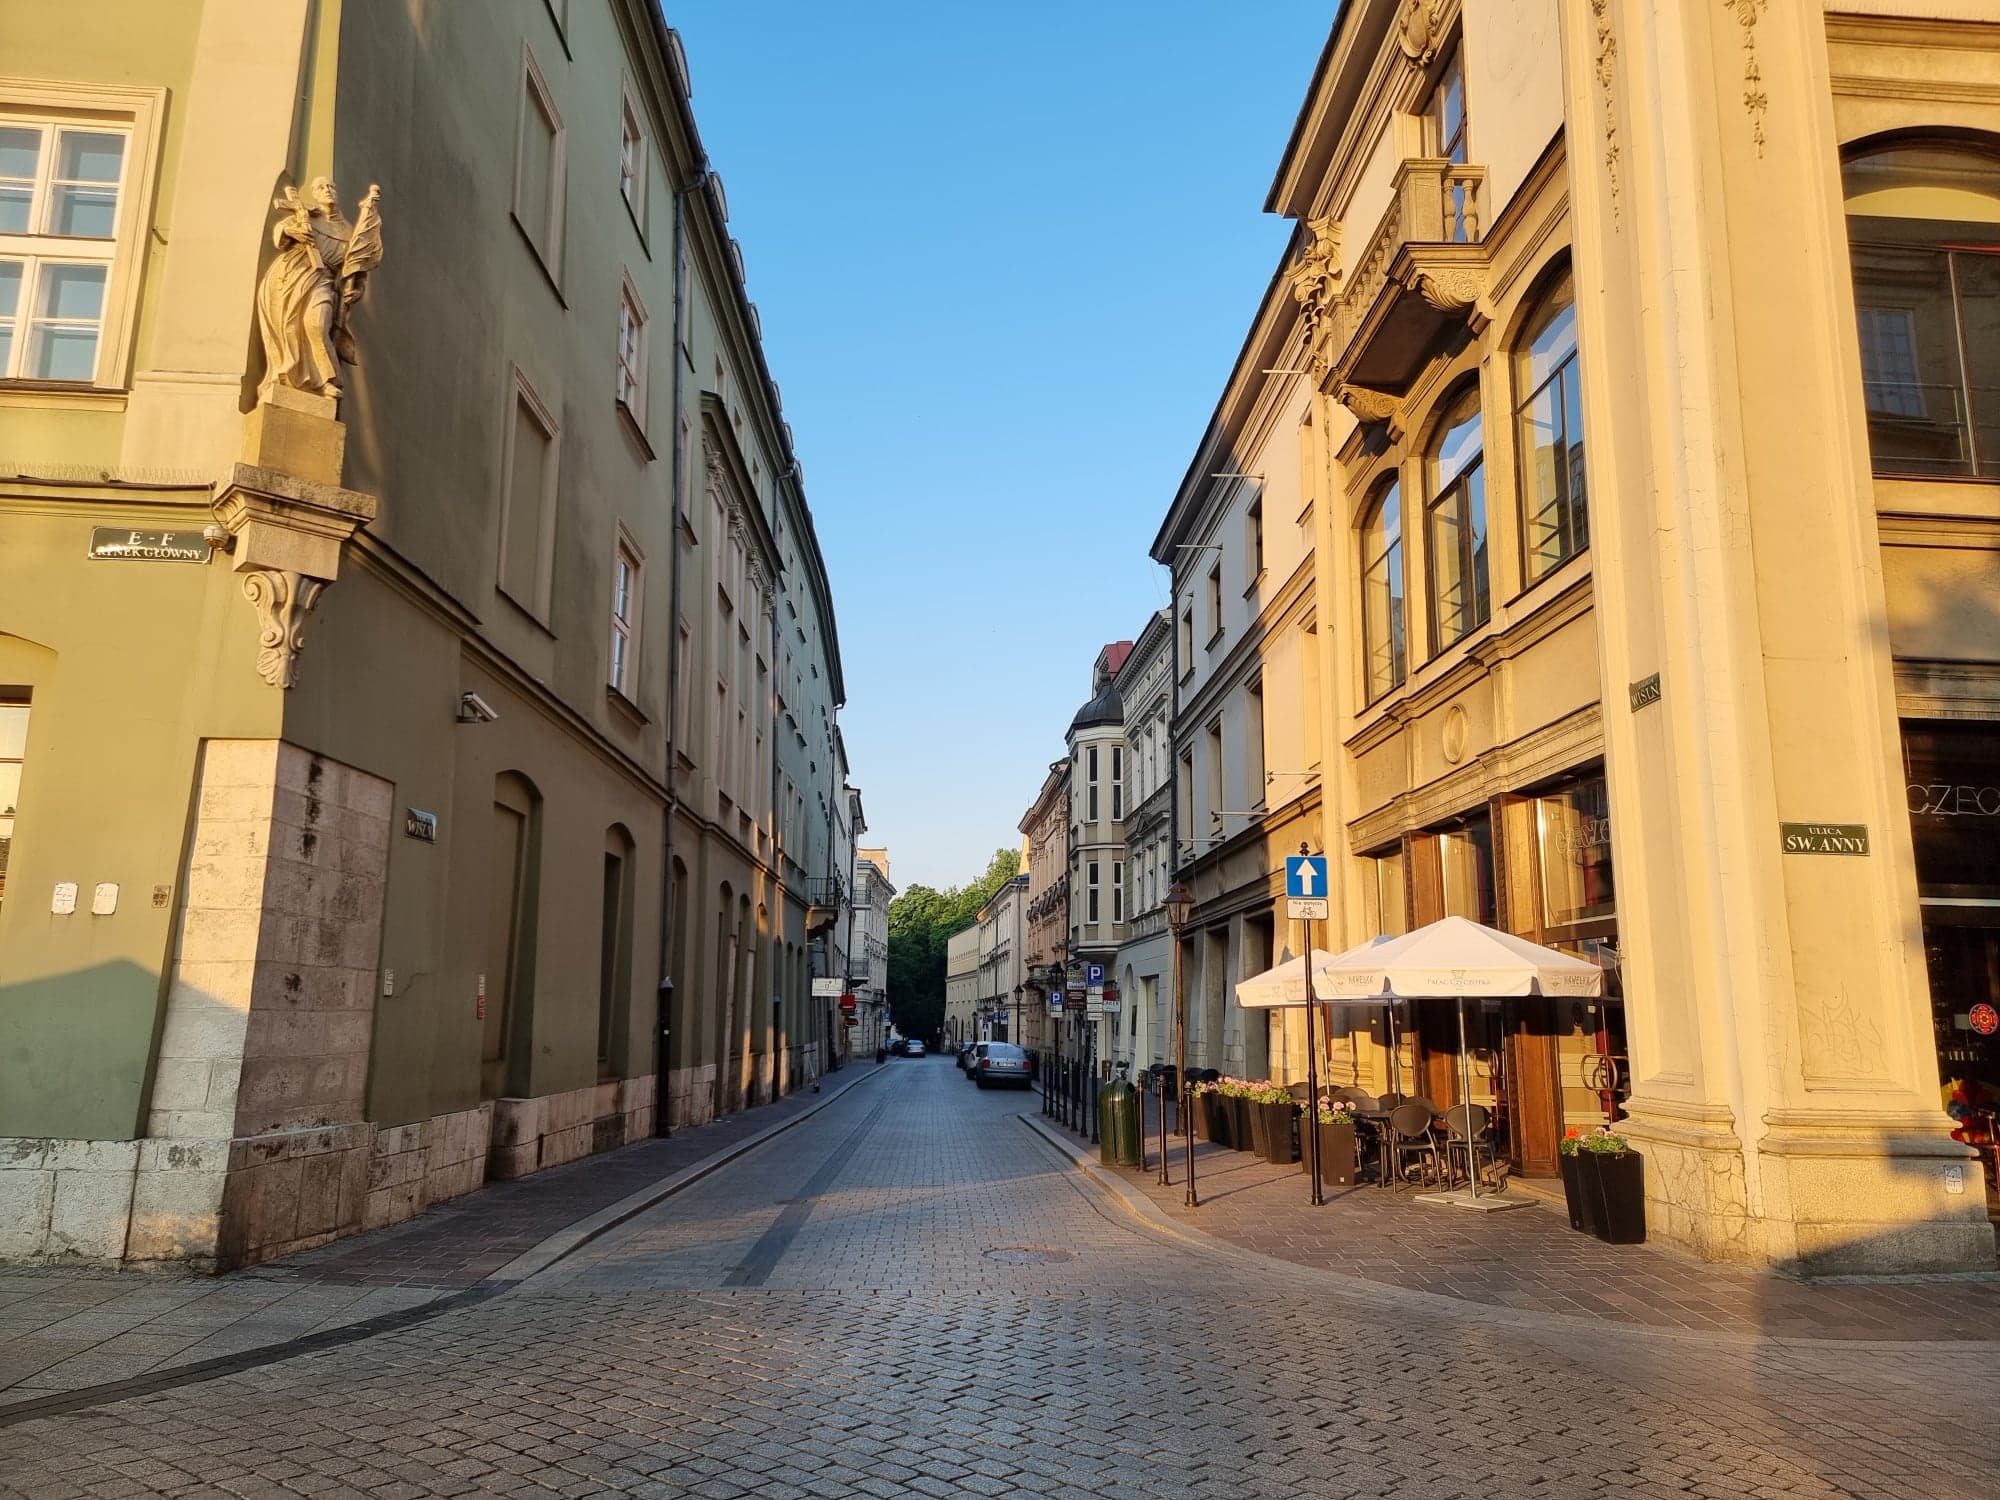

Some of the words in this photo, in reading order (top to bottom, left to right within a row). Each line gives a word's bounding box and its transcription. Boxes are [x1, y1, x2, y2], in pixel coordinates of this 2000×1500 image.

[128, 532, 143, 545] E
[161, 533, 175, 546] F
[144, 546, 202, 560] GŁÓWNY
[1808, 827, 1842, 836] ULICA
[1787, 834, 1816, 851] ŚW.
[1820, 837, 1865, 853] ANNY
[1090, 966, 1101, 980] P
